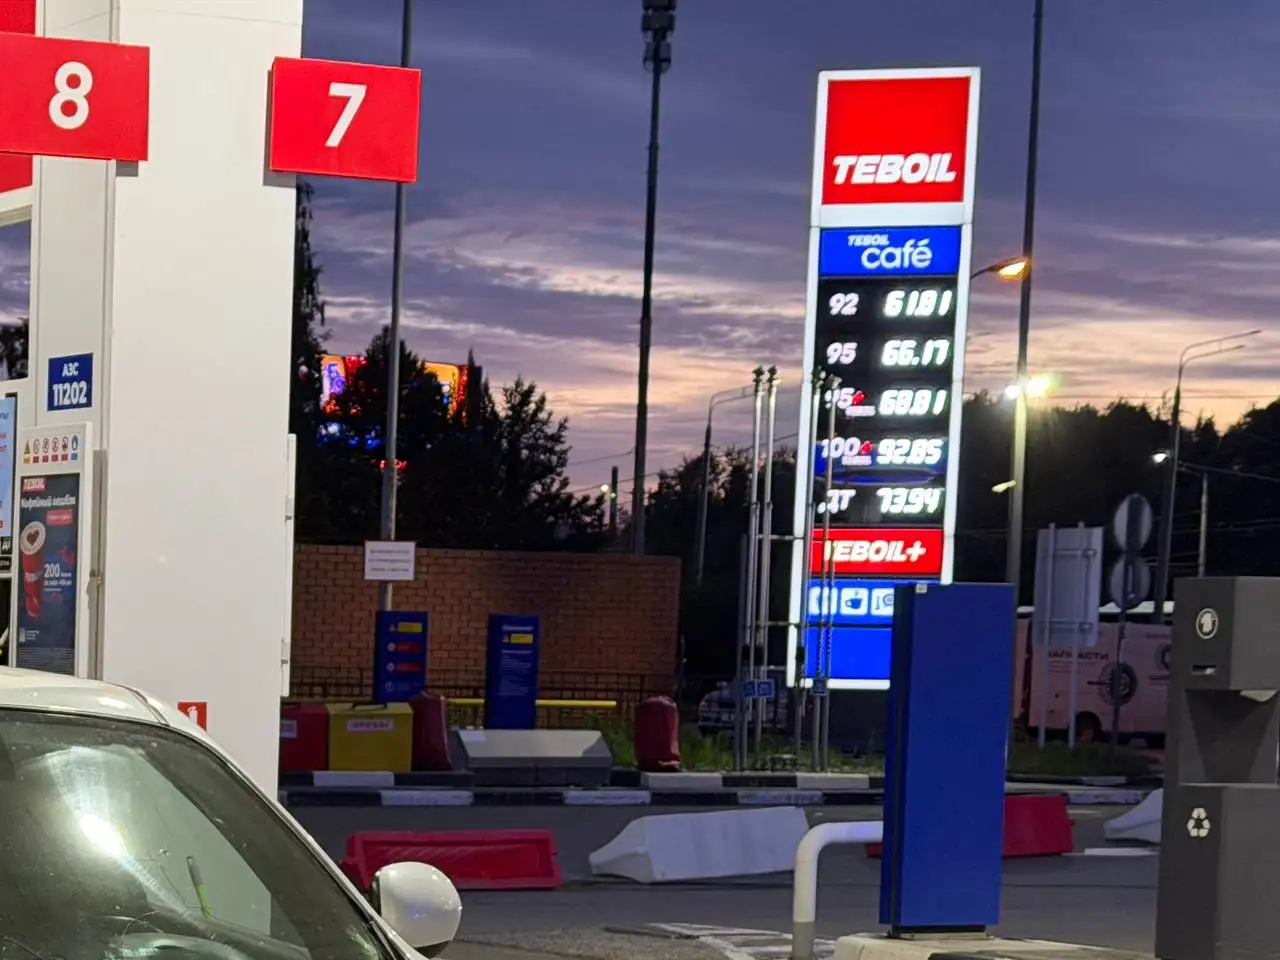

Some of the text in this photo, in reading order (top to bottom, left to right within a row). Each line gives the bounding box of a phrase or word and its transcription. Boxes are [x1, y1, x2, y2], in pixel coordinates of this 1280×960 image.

[48, 61, 94, 130] 8
[325, 82, 368, 148] 7
[832, 153, 957, 184] TEBOIL
[847, 233, 890, 247] TEBOIL
[861, 238, 933, 270] café
[828, 292, 860, 316] 92
[826, 339, 950, 367] 95 66.17
[52, 380, 88, 407] 11202
[44, 563, 61, 578] 200
